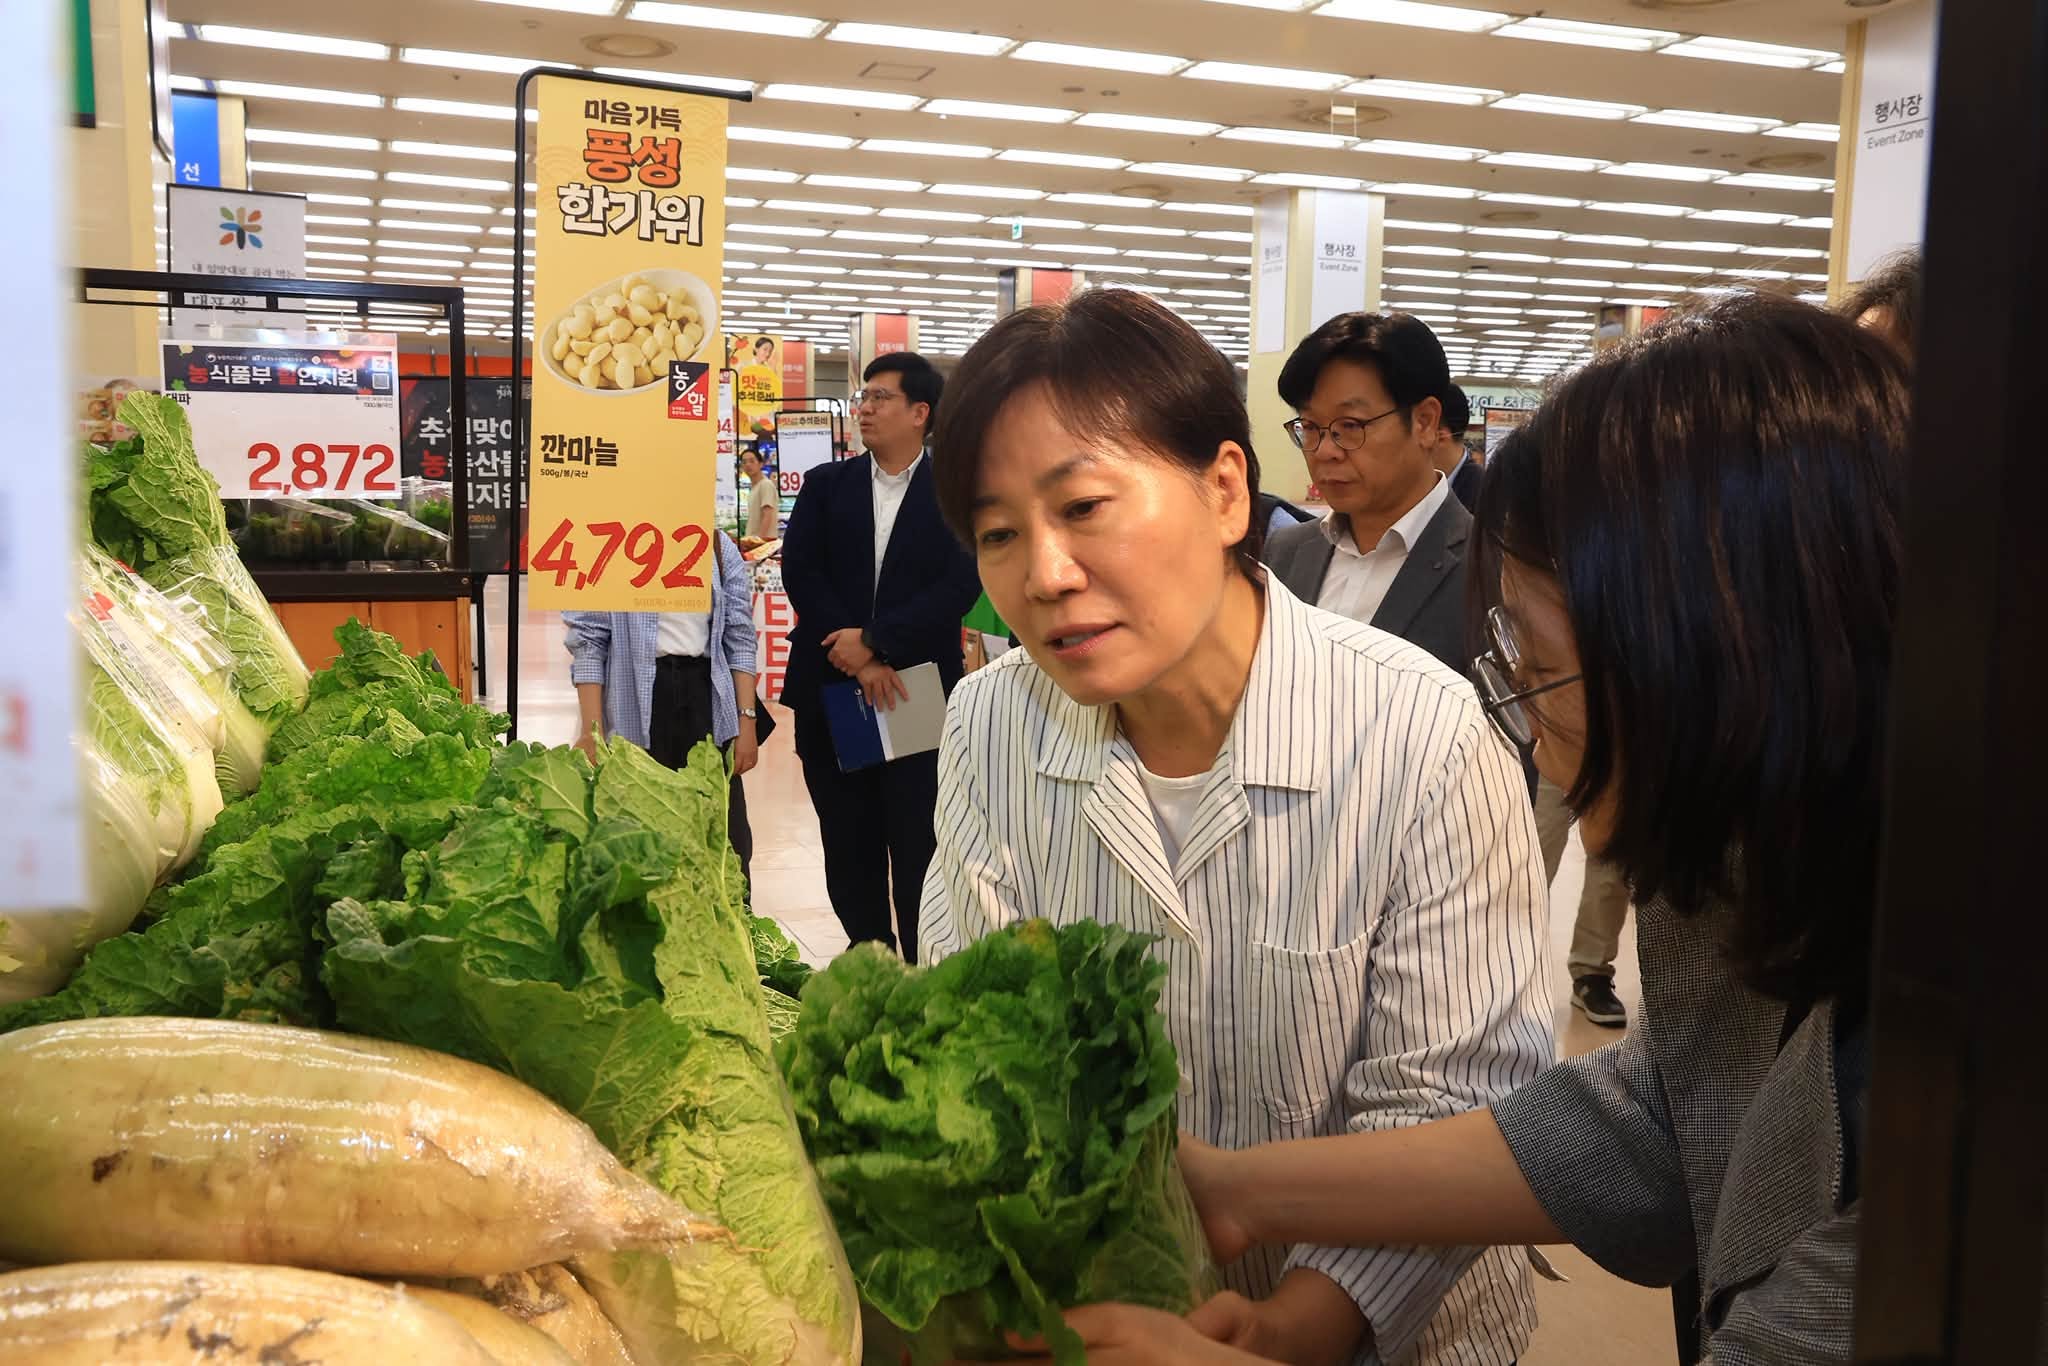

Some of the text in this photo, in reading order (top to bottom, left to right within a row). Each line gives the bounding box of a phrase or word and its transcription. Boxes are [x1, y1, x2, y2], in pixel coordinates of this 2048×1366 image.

[584, 100, 682, 132] 마음 가득
[1874, 94, 1923, 124] 행사장
[1867, 127, 1924, 150] Event Zone
[583, 128, 682, 188] 풍성
[557, 182, 704, 247] 한가위
[1324, 242, 1356, 258] 행사장
[1319, 262, 1359, 272] Event Zone
[188, 363, 273, 386] 농식품부
[672, 364, 691, 392] 농
[687, 391, 706, 417] 할
[419, 416, 525, 446] 추맞이
[540, 434, 619, 467] 깐마늘
[247, 442, 396, 496] 2,872
[530, 518, 710, 591] 4,792
